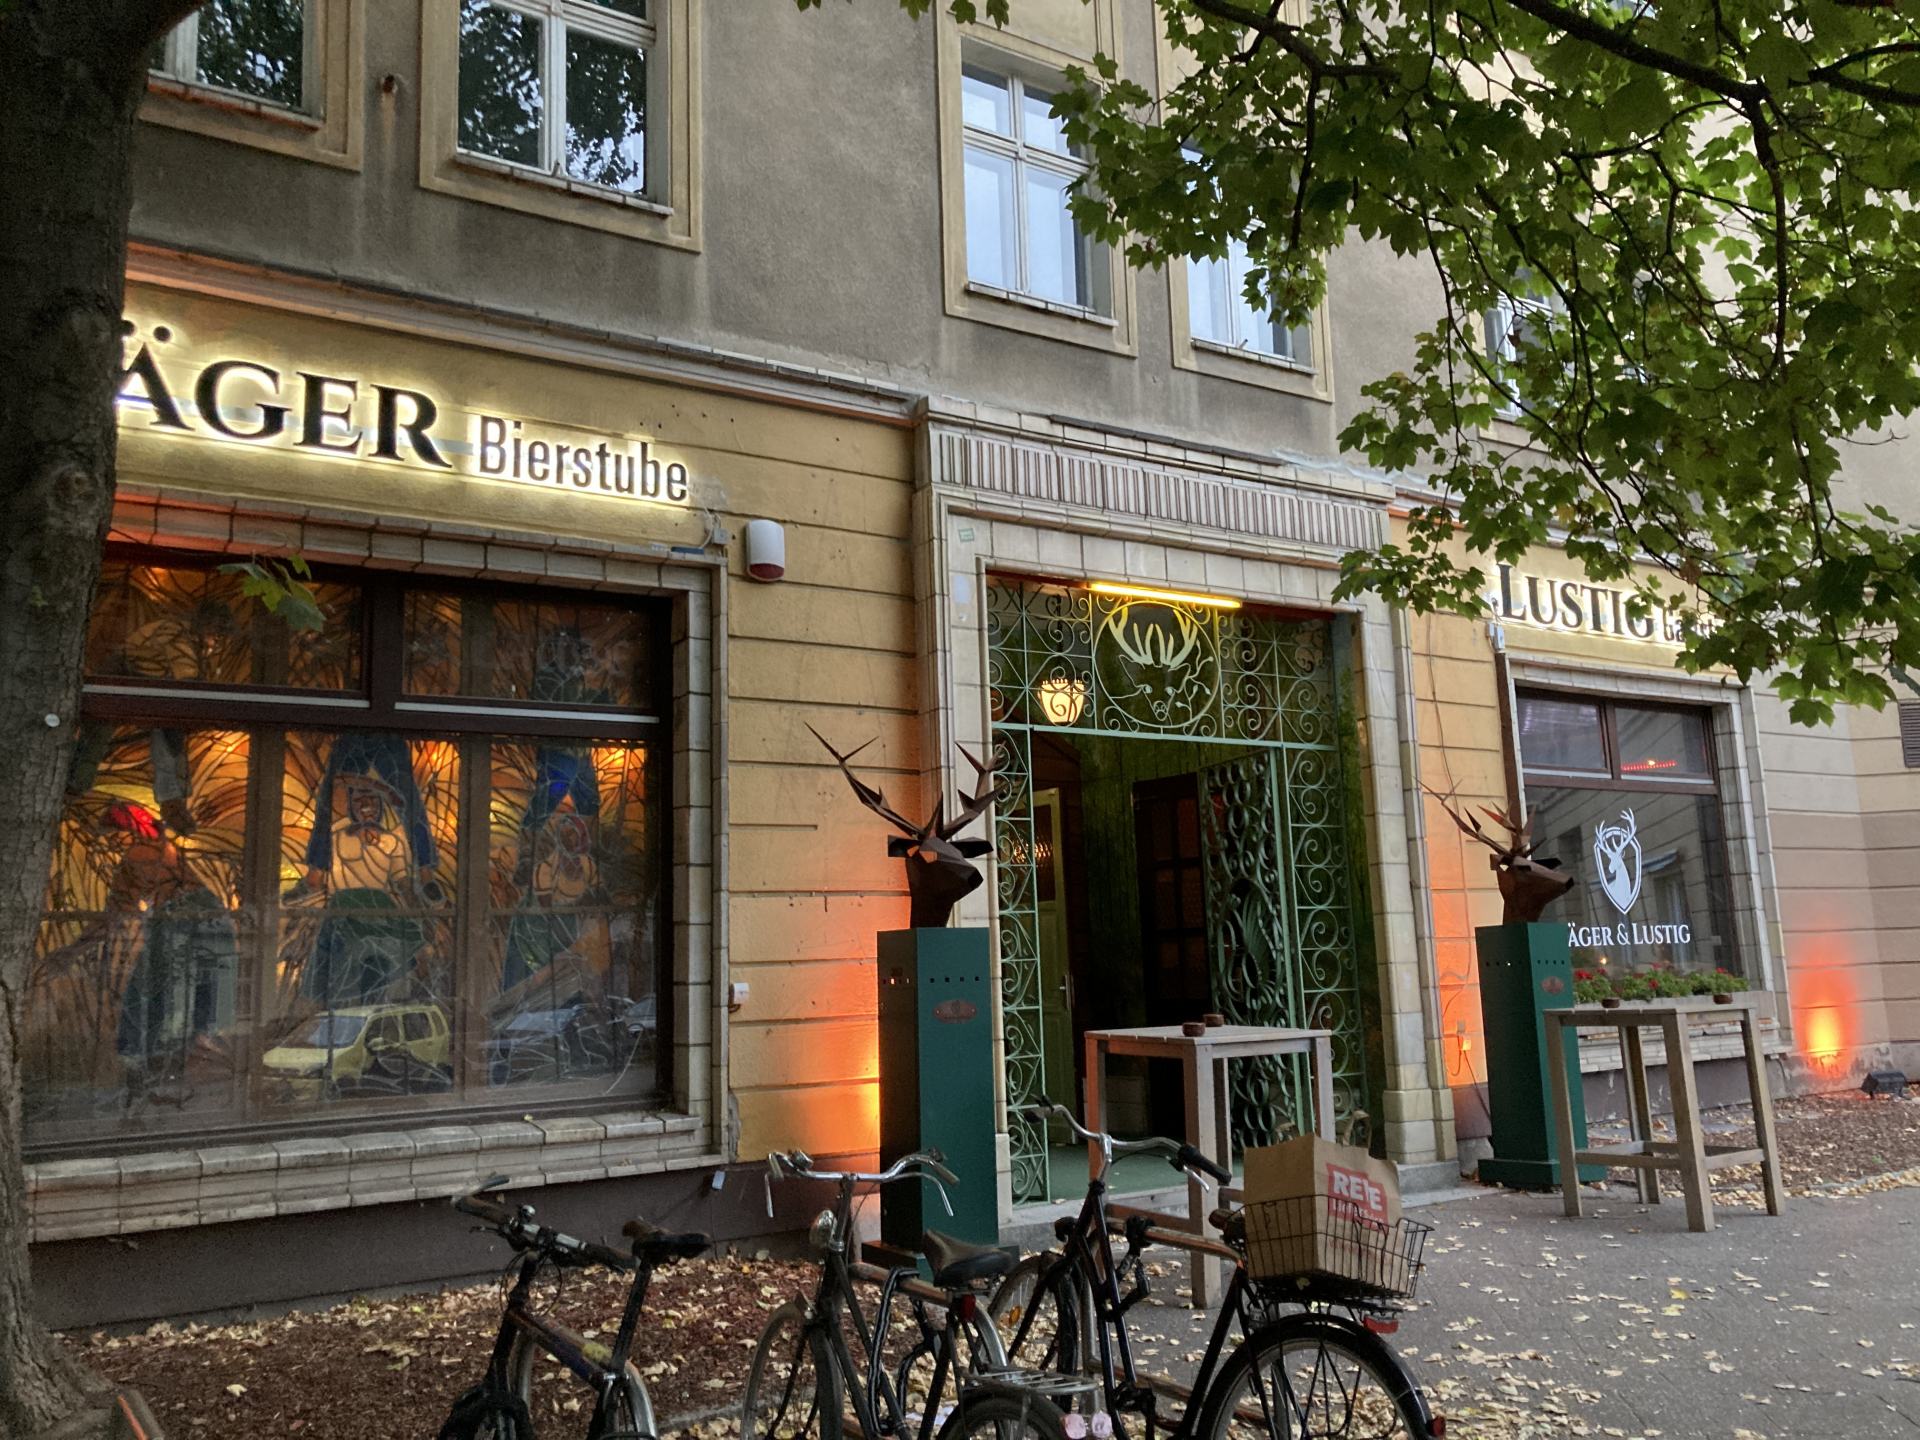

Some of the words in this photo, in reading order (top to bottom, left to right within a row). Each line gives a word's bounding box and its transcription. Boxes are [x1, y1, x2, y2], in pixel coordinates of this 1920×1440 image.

[116, 319, 453, 468] ÄGER
[480, 415, 688, 502] Bierstube
[1498, 564, 1655, 638] LUSTIG
[1567, 922, 1615, 948] ÄGER
[1616, 922, 1631, 946] &
[1631, 922, 1691, 945] LUSTIG
